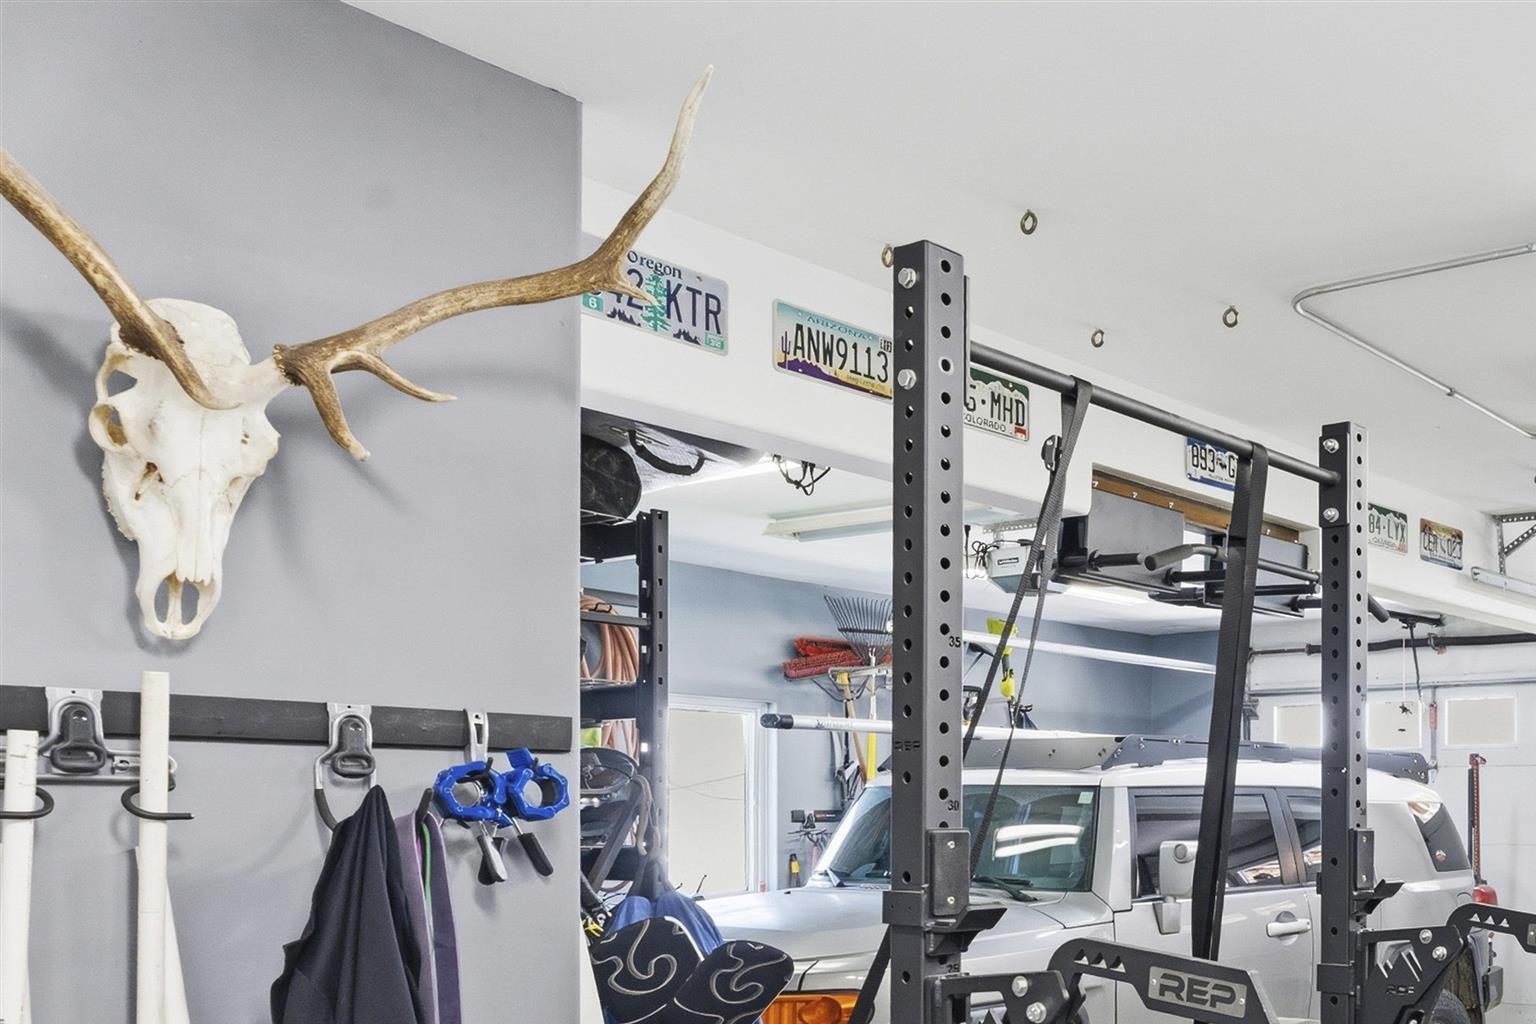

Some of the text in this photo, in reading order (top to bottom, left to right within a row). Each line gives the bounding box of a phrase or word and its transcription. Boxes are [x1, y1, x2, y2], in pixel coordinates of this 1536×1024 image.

[627, 250, 683, 280] Oregon
[666, 280, 721, 335] KTR
[807, 316, 869, 339] ARIZONA
[793, 323, 888, 383] ANW9113
[965, 413, 1007, 433] OLORADO
[948, 635, 962, 648] 35
[947, 800, 960, 812] 30
[1159, 972, 1236, 1009] REP
